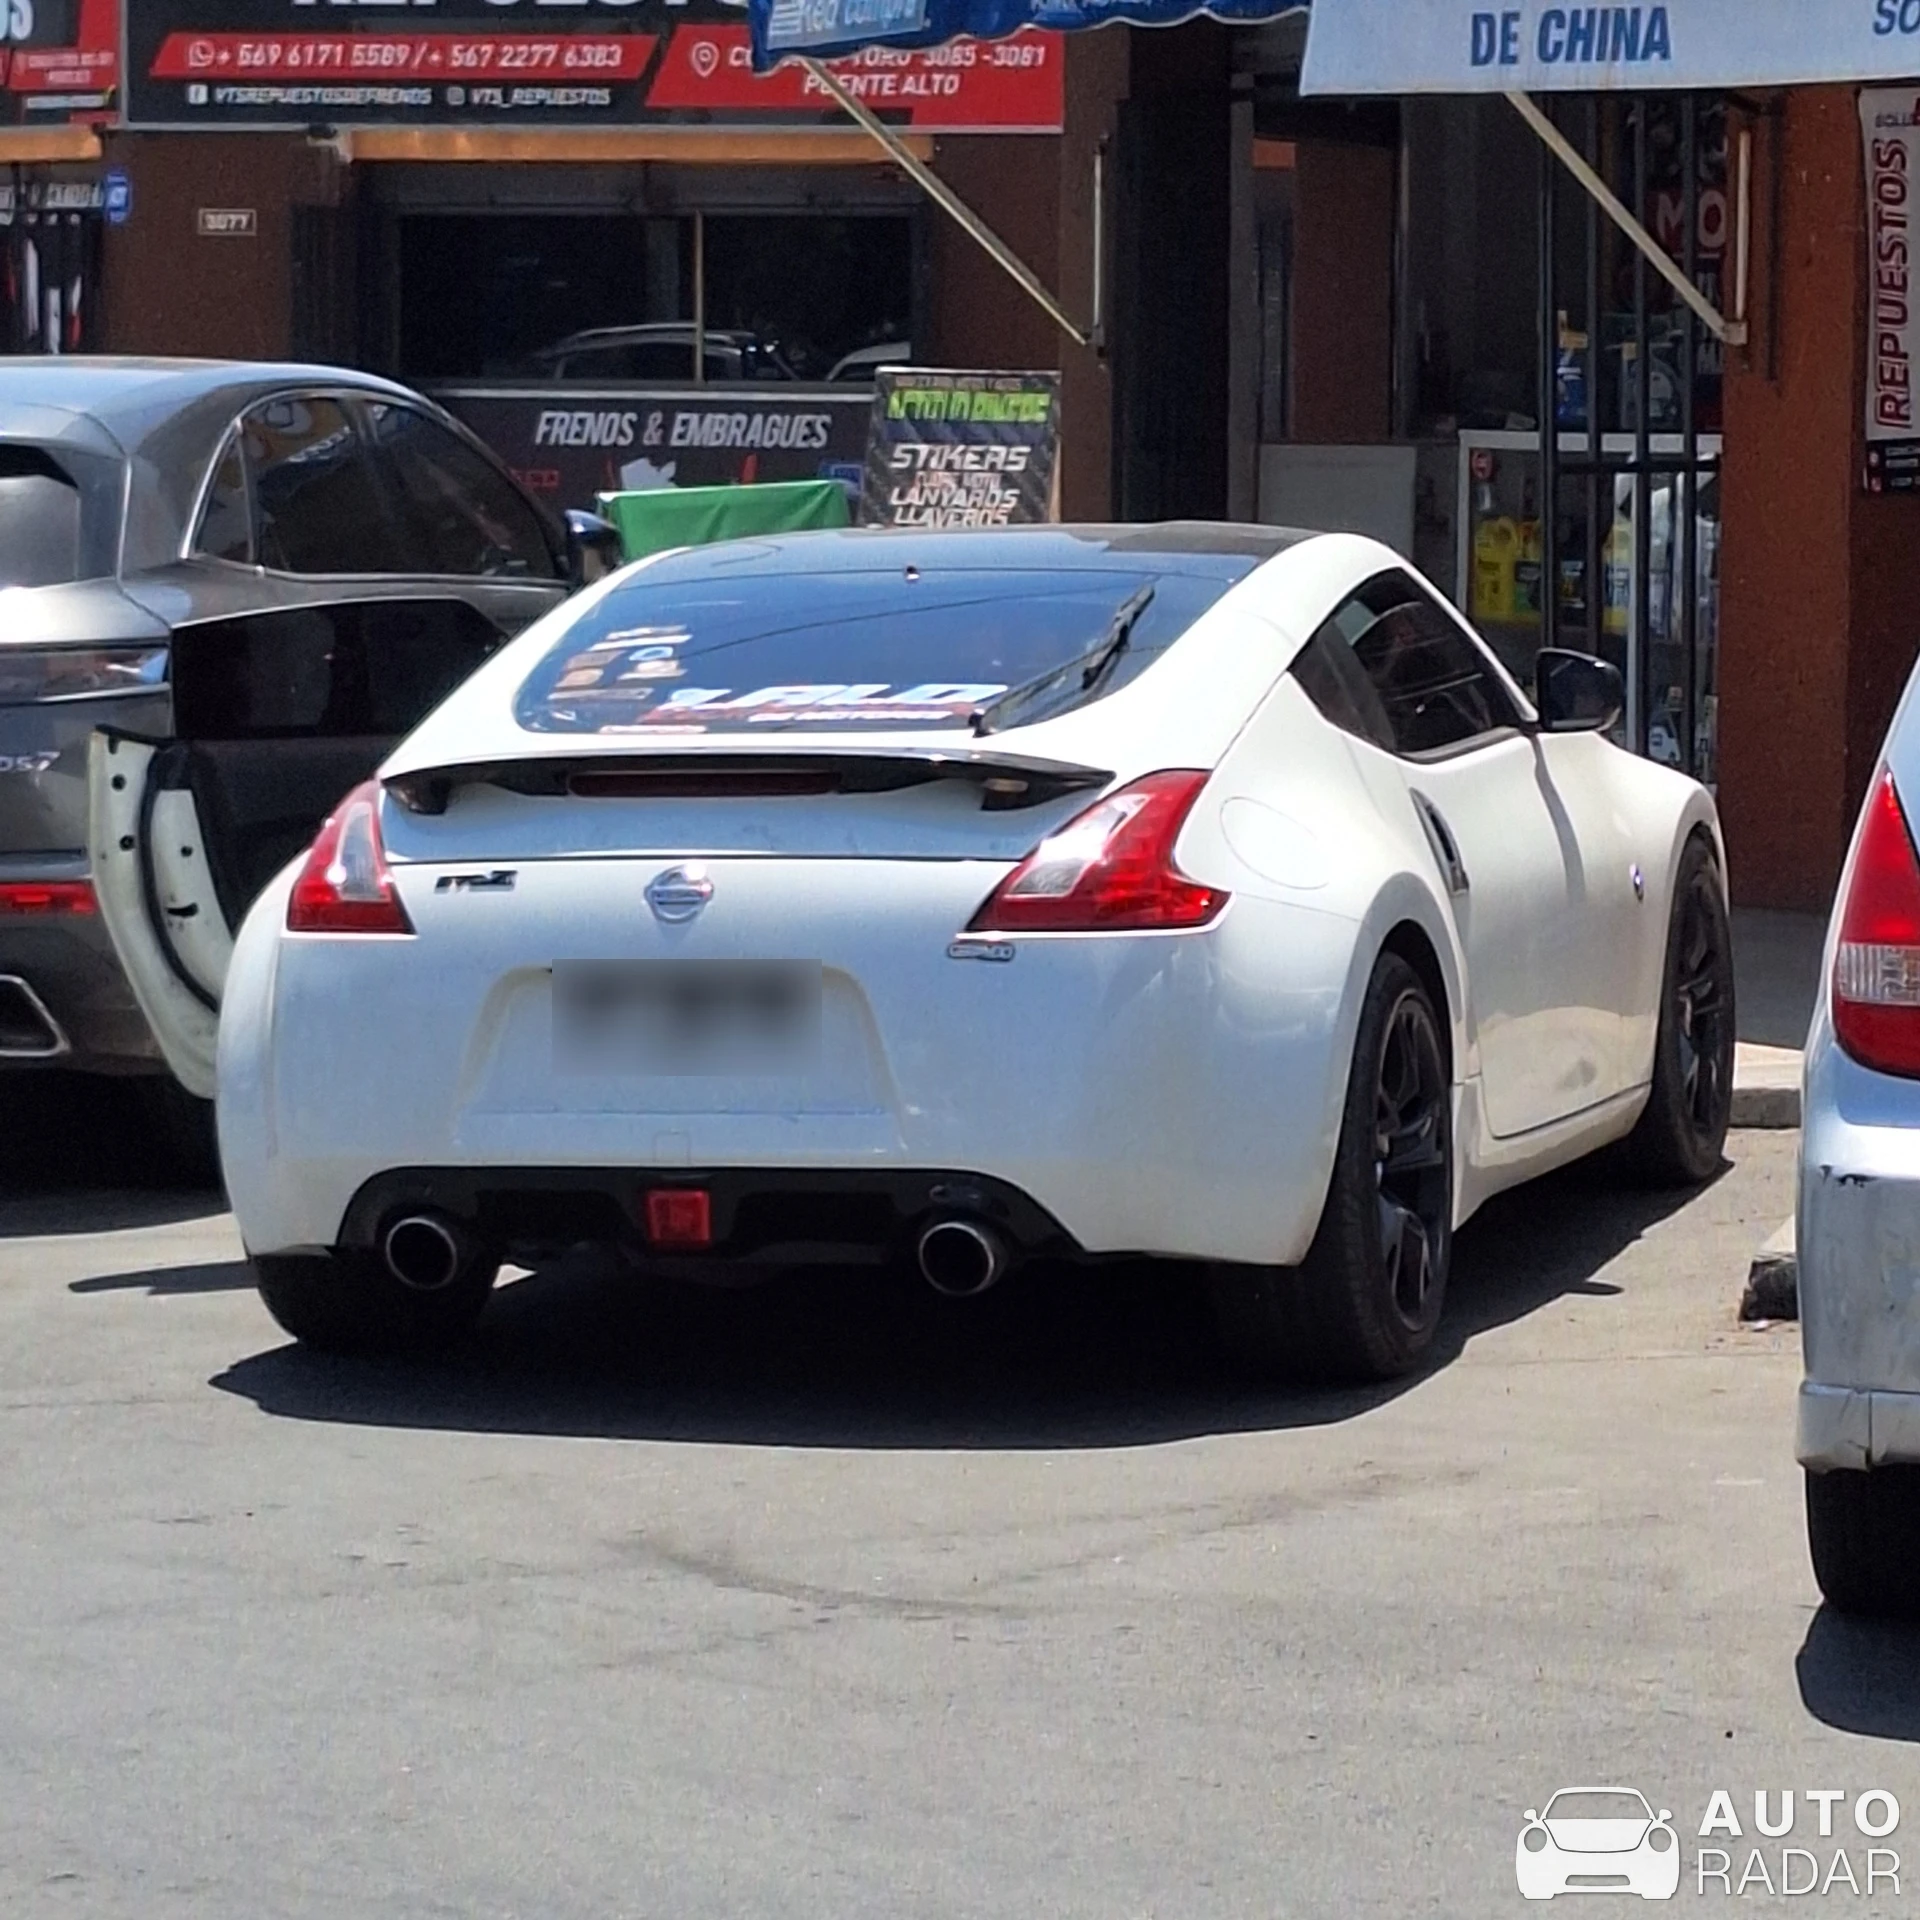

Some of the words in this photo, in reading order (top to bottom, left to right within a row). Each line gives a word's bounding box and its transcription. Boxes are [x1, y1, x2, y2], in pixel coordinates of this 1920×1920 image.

[239, 44, 282, 66] 569
[287, 44, 345, 66] 6171
[451, 44, 495, 66] 567
[498, 44, 560, 66] 2277
[564, 44, 623, 66] 6383
[1470, 11, 1520, 66] DE
[1538, 7, 1671, 63] CHINA
[901, 74, 961, 95] ALTO
[1873, 138, 1912, 428] REPUESTOS
[535, 410, 638, 446] FRENOS
[642, 410, 664, 446] &
[669, 411, 833, 449] EMBRAGUES
